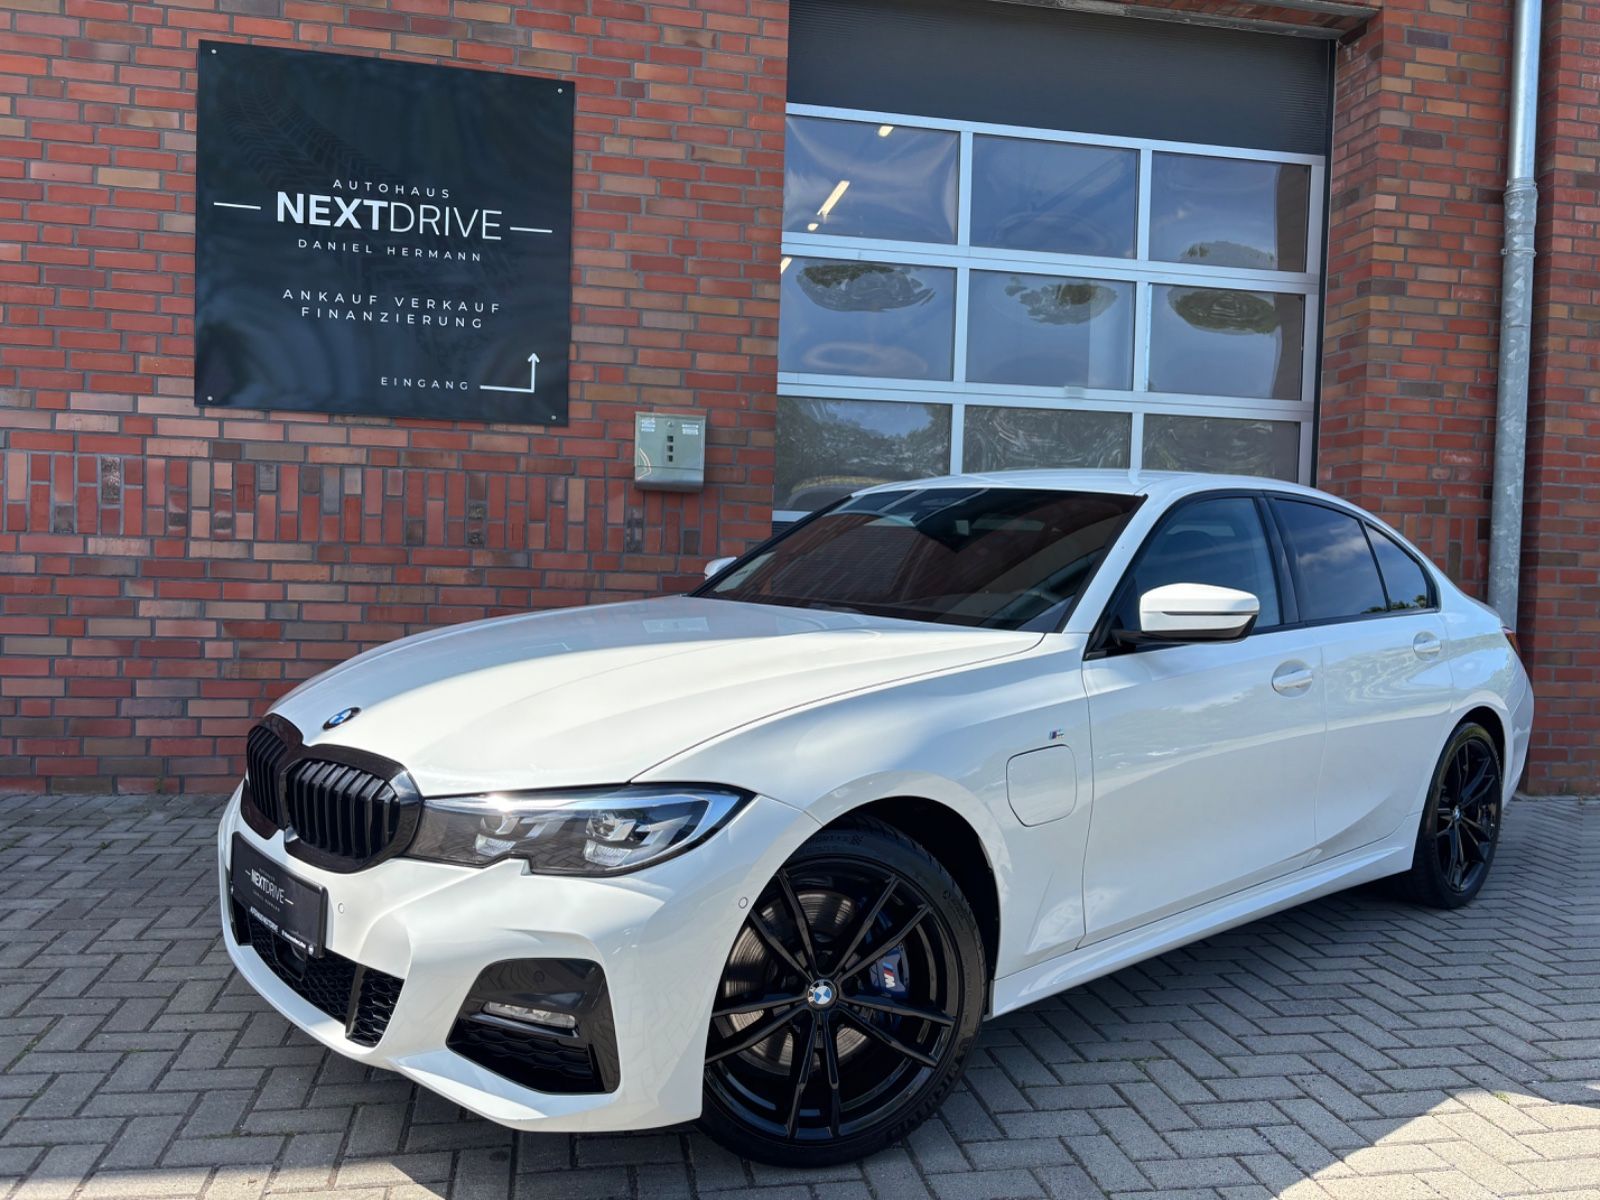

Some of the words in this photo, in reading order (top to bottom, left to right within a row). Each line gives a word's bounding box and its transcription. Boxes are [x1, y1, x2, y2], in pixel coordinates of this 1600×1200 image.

[332, 178, 450, 199] AUTOHAUS
[276, 190, 503, 241] NEXTDRIVE
[297, 238, 373, 255] DANIEL
[386, 246, 482, 262] HERMANN
[282, 288, 379, 306] ANKAUF
[394, 296, 501, 314] VERKAUF
[301, 306, 483, 329] FINANZIERUNG
[380, 376, 470, 392] EINGANG
